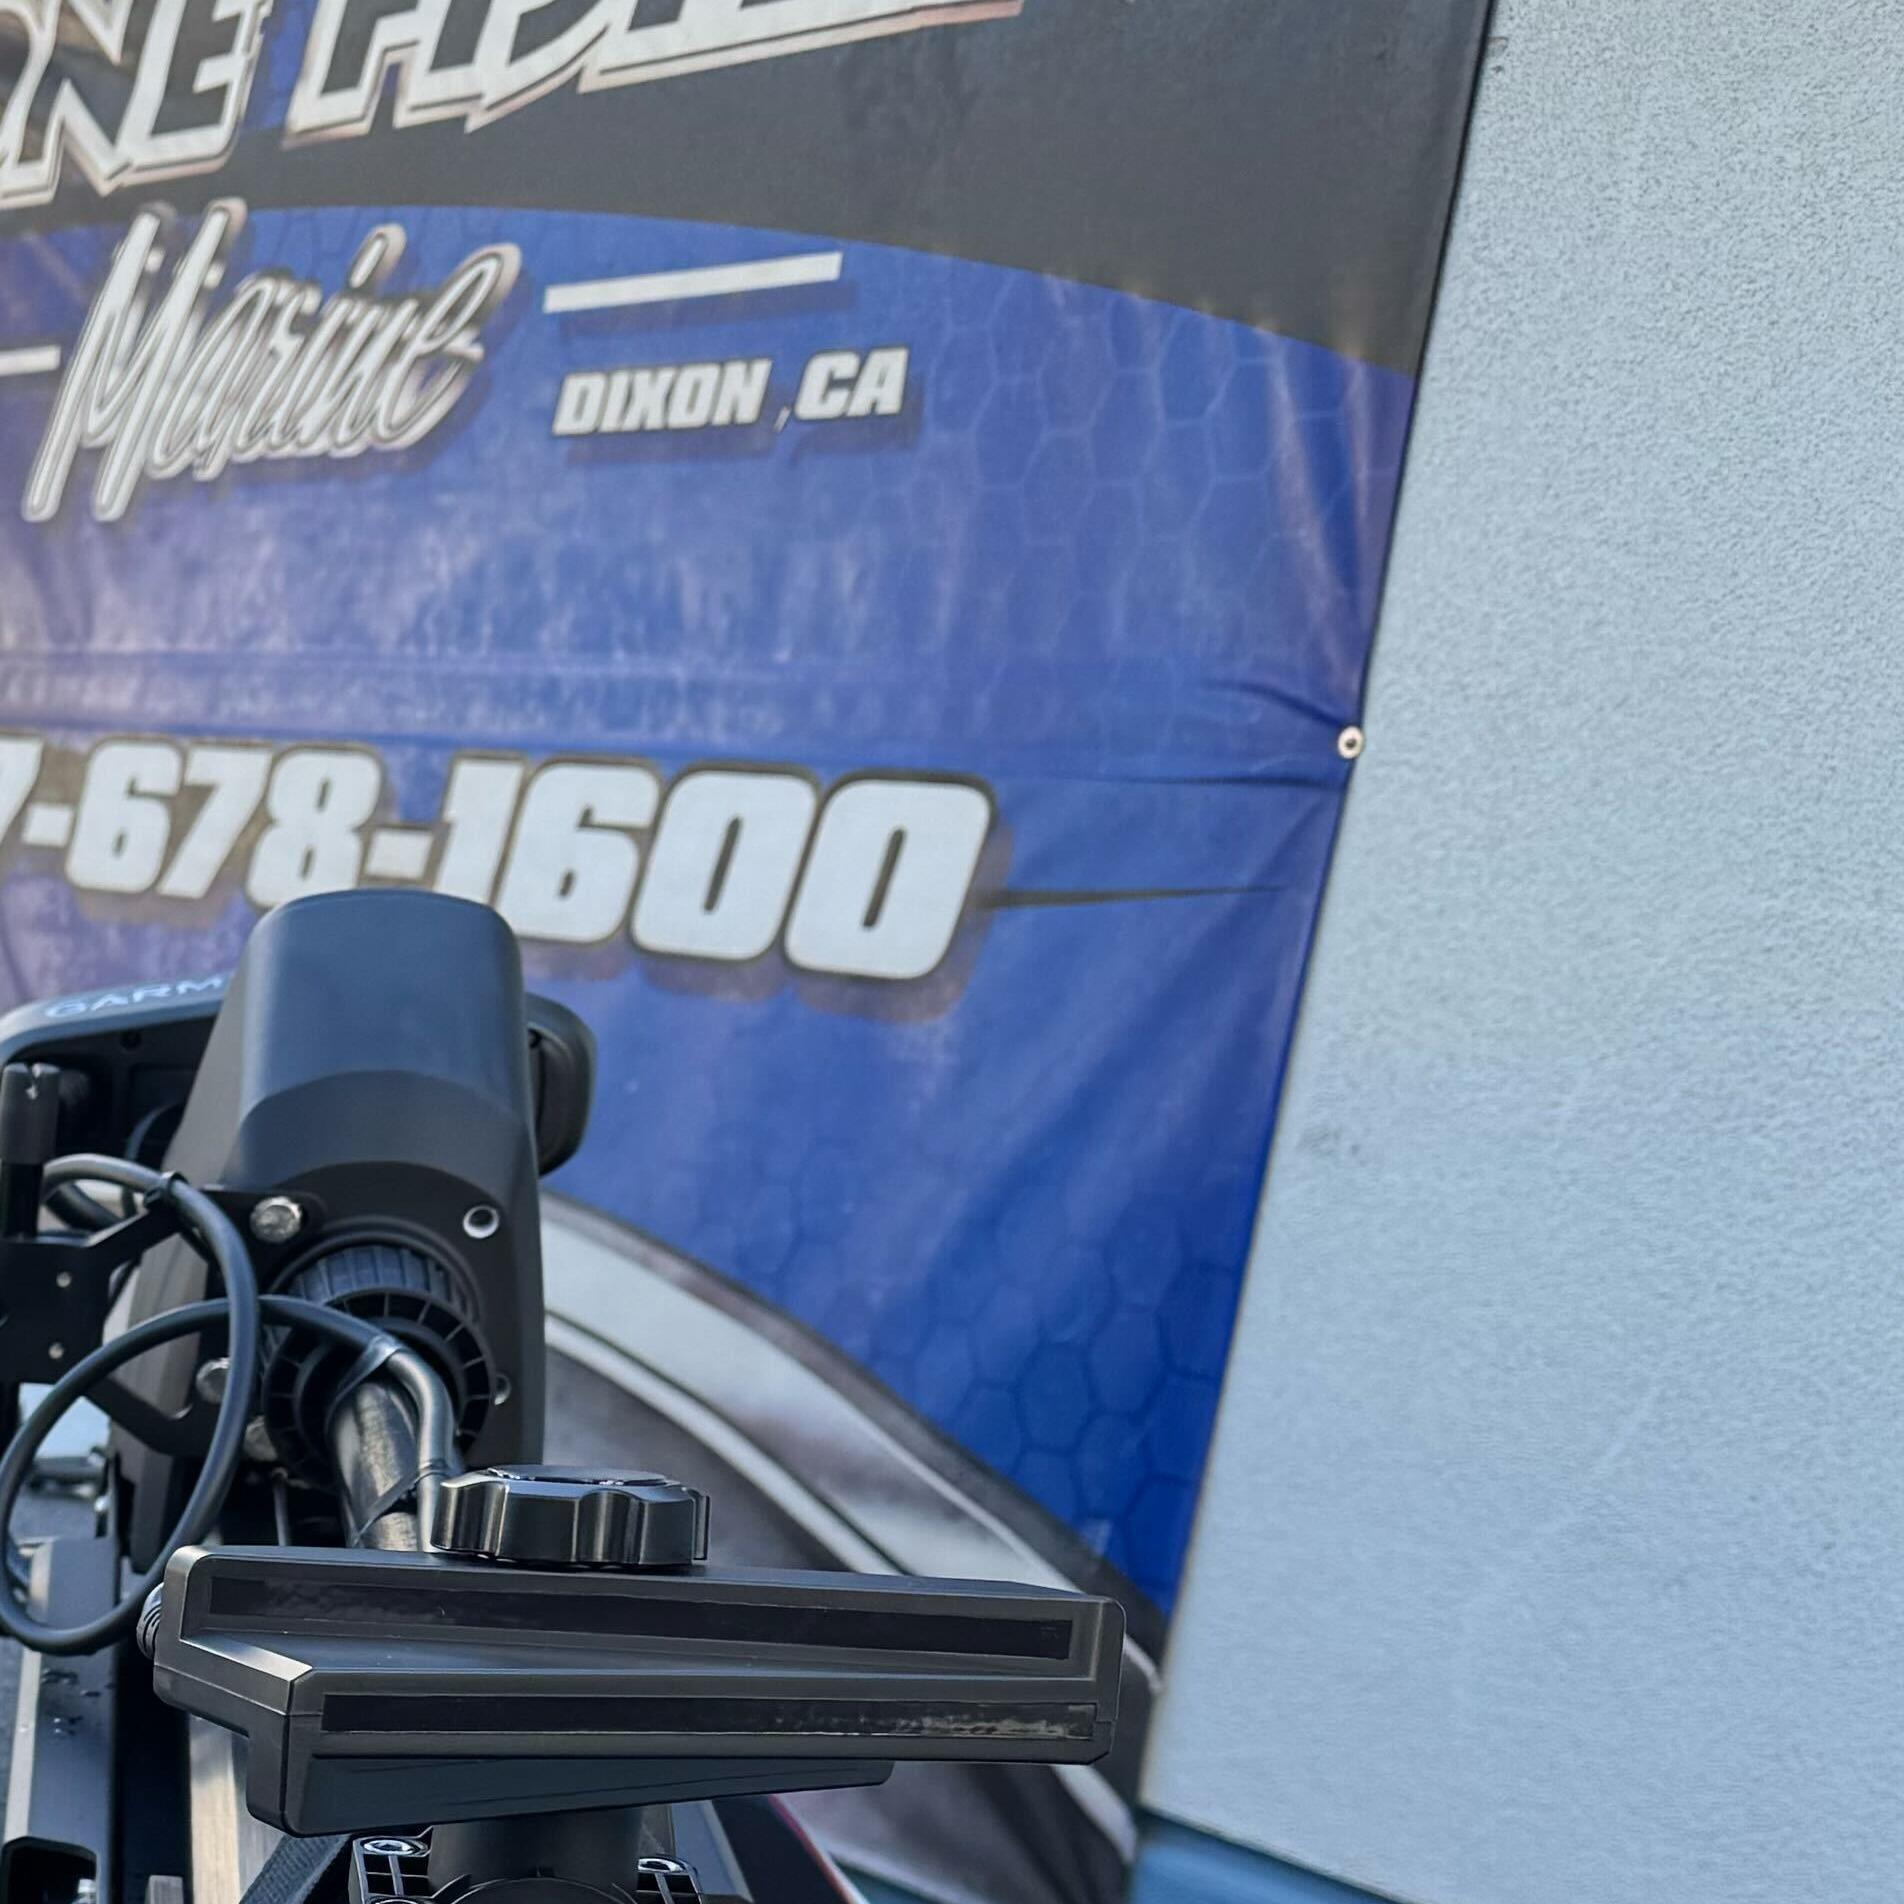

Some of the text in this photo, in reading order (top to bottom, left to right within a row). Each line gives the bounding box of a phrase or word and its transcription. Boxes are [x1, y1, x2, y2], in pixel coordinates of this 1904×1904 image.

[22, 199, 521, 521] Marine
[551, 357, 772, 437] DIXON
[44, 974, 226, 1019] GARM
